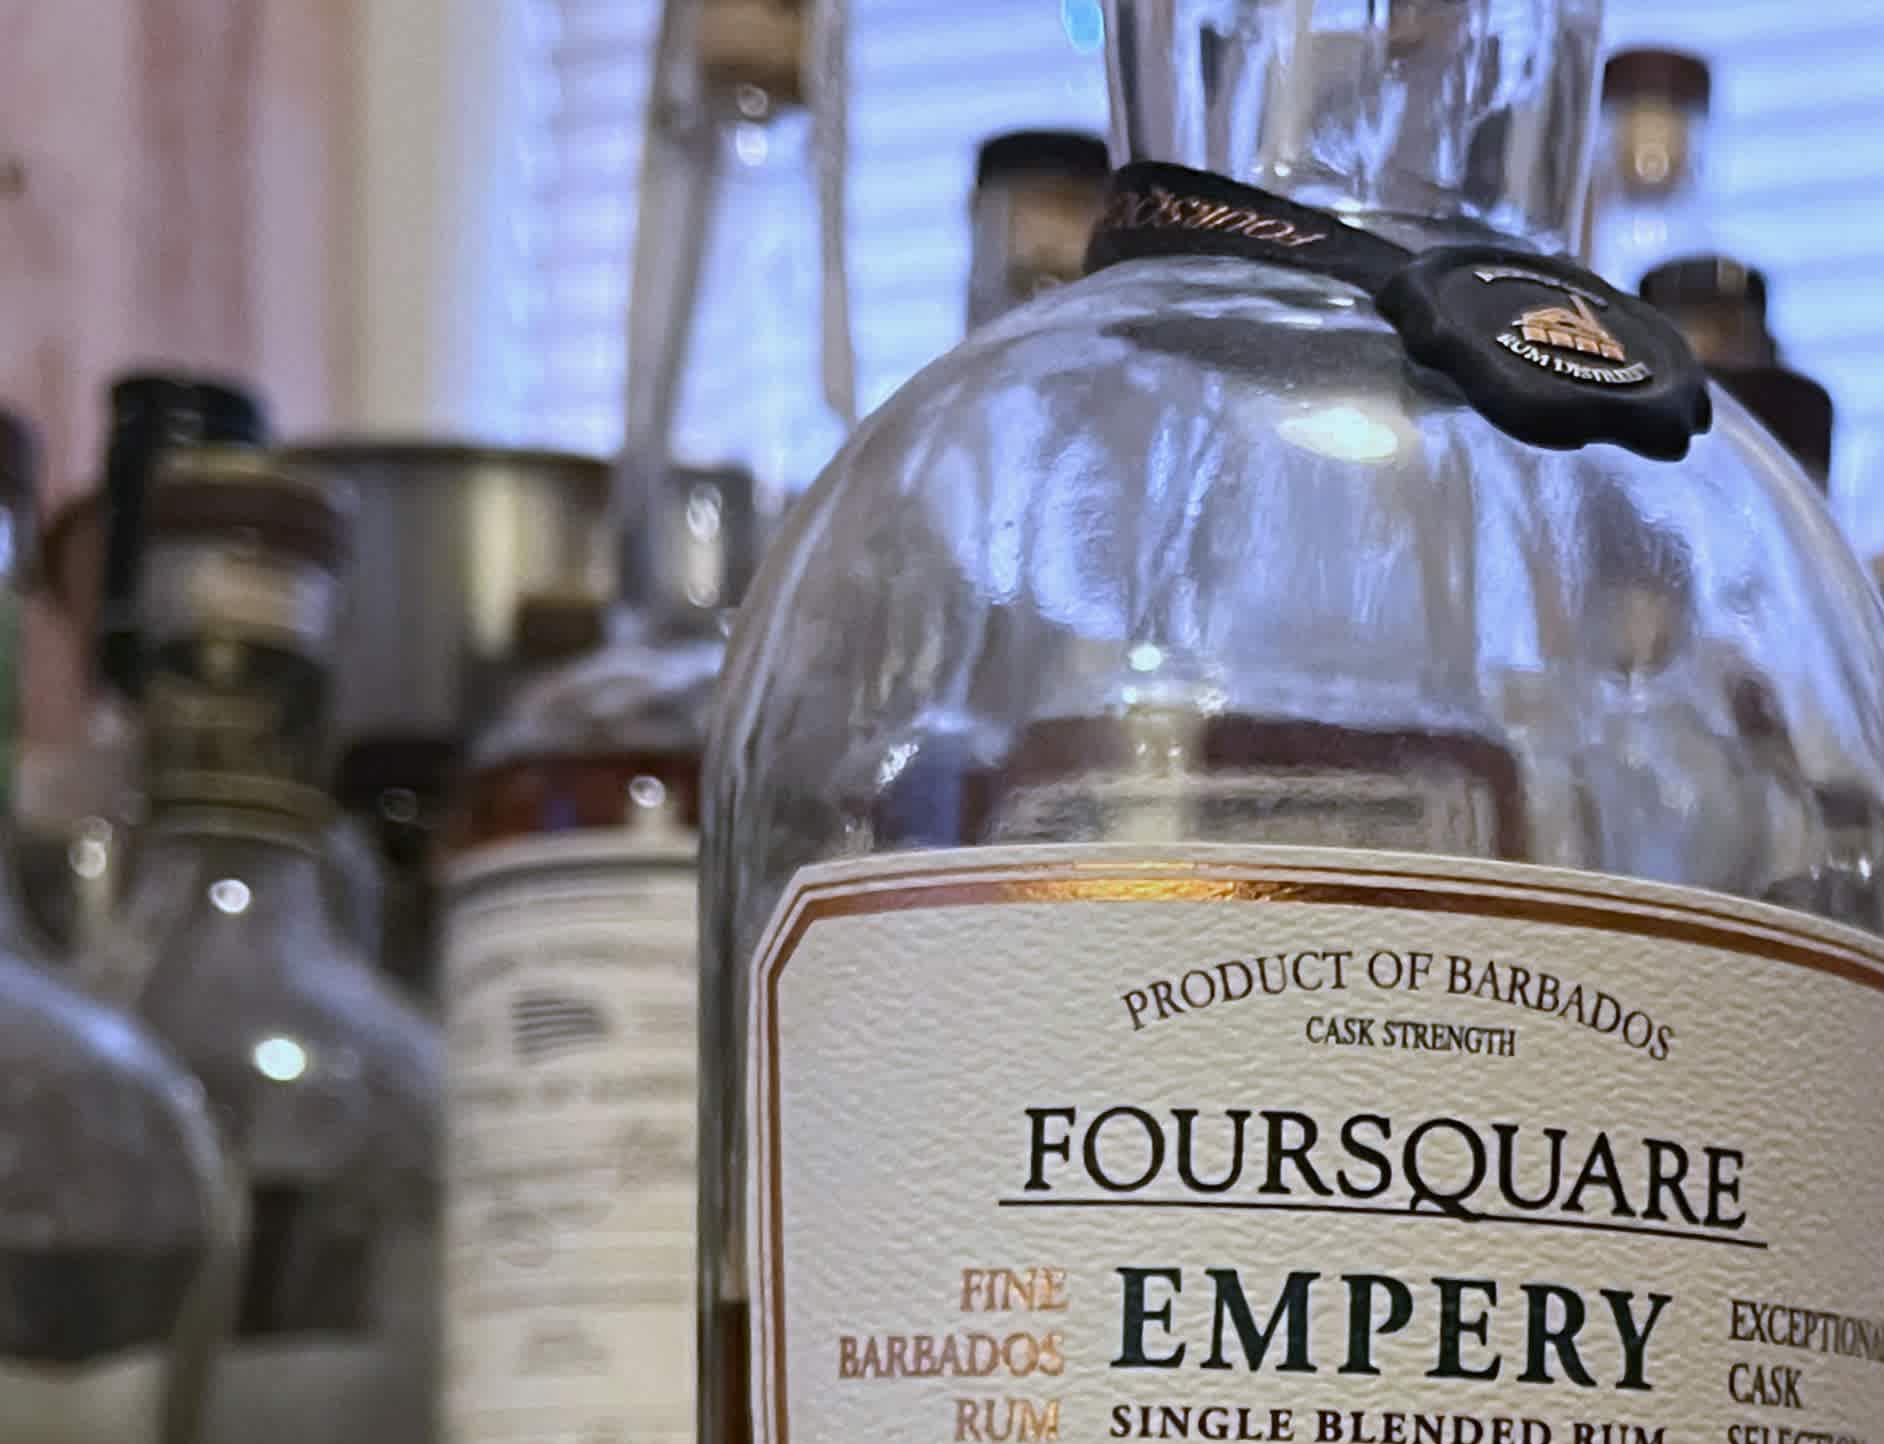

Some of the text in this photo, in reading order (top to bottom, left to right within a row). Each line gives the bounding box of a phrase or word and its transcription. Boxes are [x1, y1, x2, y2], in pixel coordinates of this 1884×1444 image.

[1122, 949, 1677, 1063] PRODUCT OF BARBADOS
[1305, 1015, 1517, 1057] CASK STRENGTH
[1023, 1106, 1748, 1230] FOURSQUARE
[959, 1266, 1068, 1313] FINE
[1109, 1266, 1673, 1391] EMPERY
[838, 1331, 1066, 1379] BARBADOS
[1729, 1362, 1803, 1409] CASK
[953, 1397, 1062, 1441] RUM
[1109, 1404, 1294, 1442] SINGLE
